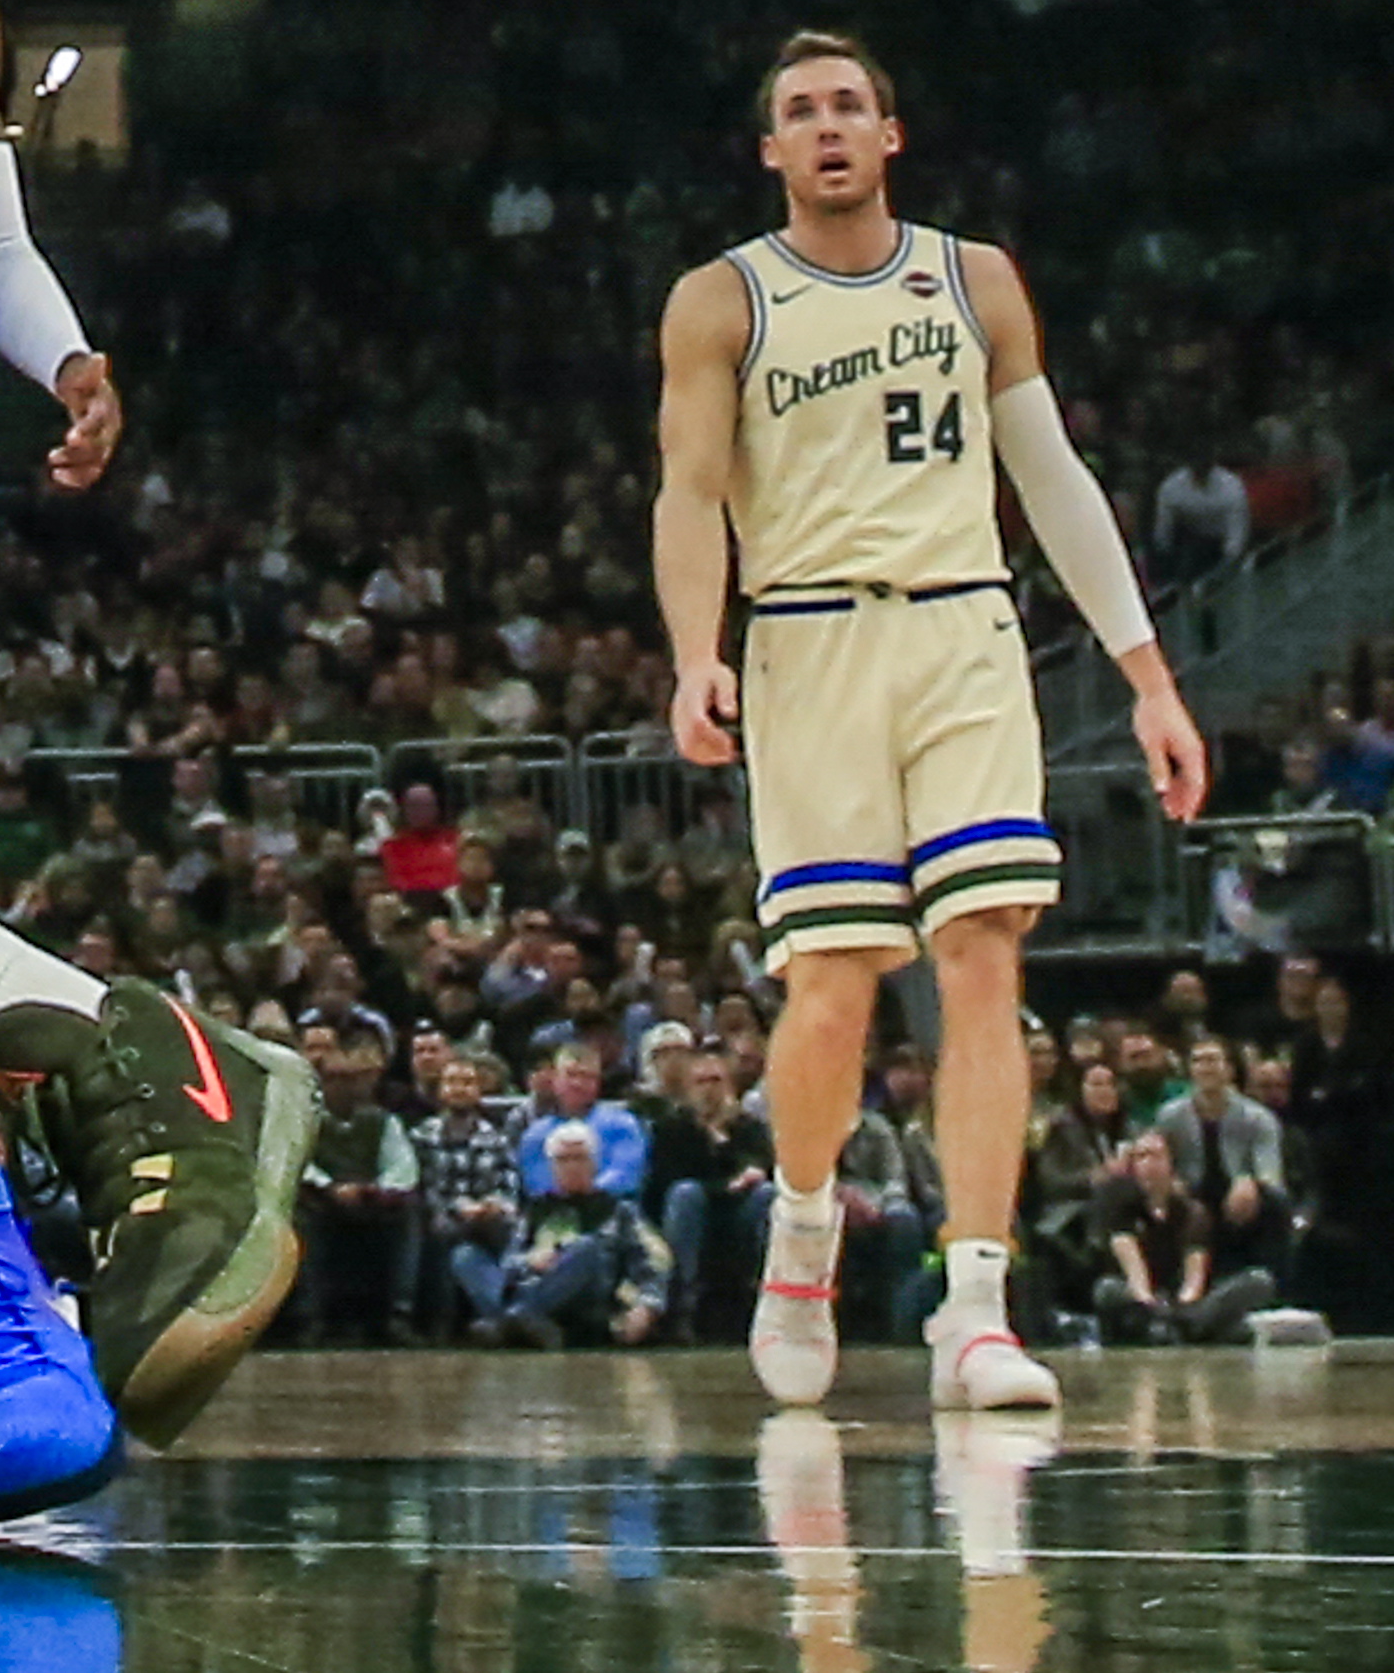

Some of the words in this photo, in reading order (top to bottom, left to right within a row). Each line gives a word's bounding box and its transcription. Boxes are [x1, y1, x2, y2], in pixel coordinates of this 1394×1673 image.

[767, 347, 884, 417] Cream
[889, 317, 962, 376] City
[883, 391, 964, 463] 24
